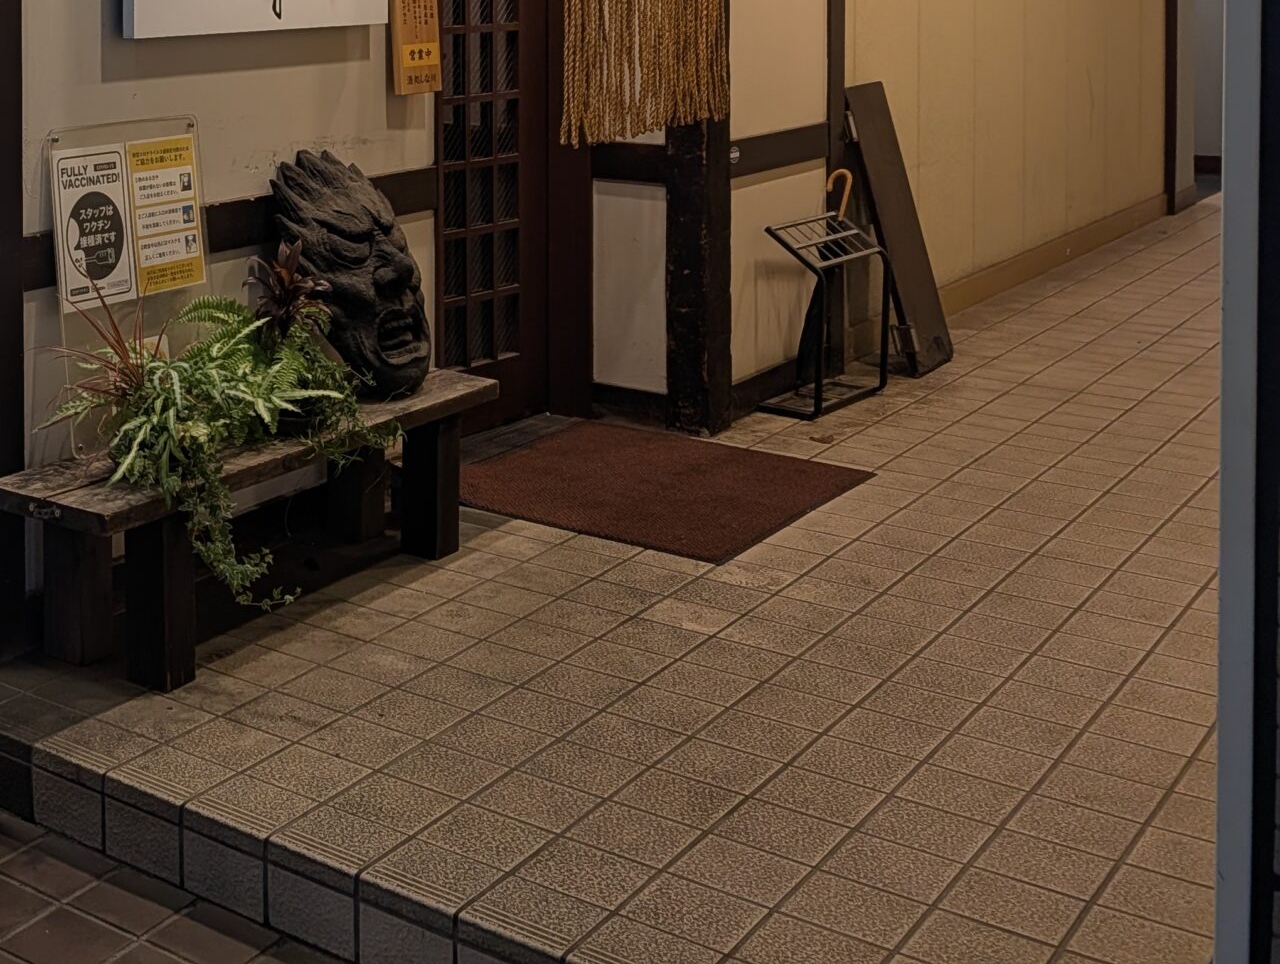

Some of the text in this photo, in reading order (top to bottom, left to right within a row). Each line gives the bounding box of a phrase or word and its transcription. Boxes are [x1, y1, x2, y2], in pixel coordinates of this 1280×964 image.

[408, 47, 433, 62] 営業中
[60, 164, 89, 179] FULLY
[61, 172, 121, 191] VACCINATED!
[79, 205, 114, 221] スタッフは
[82, 220, 112, 232] ワクチン
[79, 232, 117, 249] 接種済です
